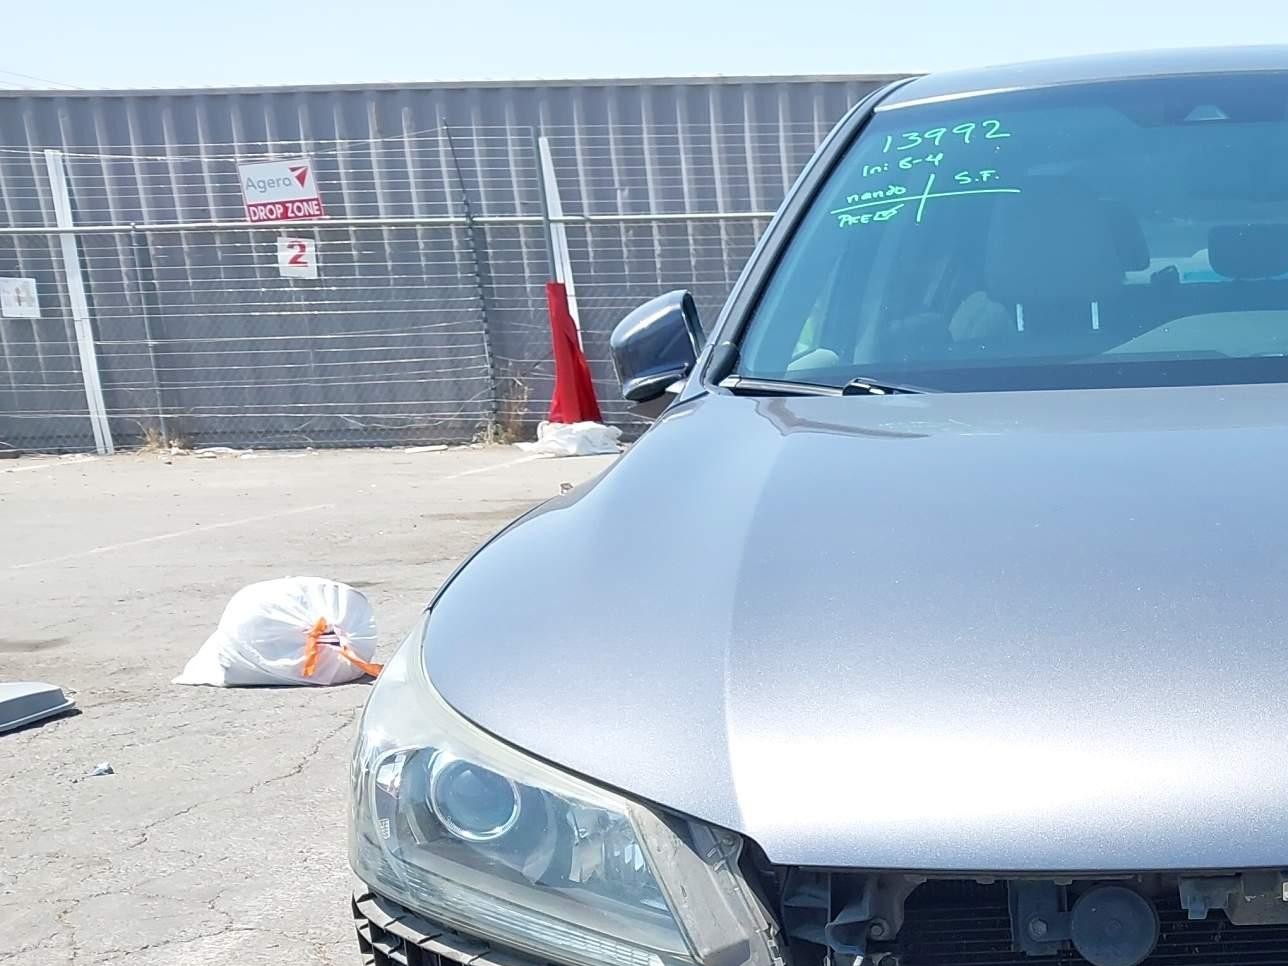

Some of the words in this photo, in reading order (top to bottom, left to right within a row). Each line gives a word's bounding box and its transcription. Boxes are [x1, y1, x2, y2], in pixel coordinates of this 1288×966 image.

[883, 120, 1011, 152] 13992
[245, 177, 292, 192] Agero
[249, 204, 283, 221] DROP
[285, 201, 321, 218] ZONE
[286, 240, 309, 268] 2
